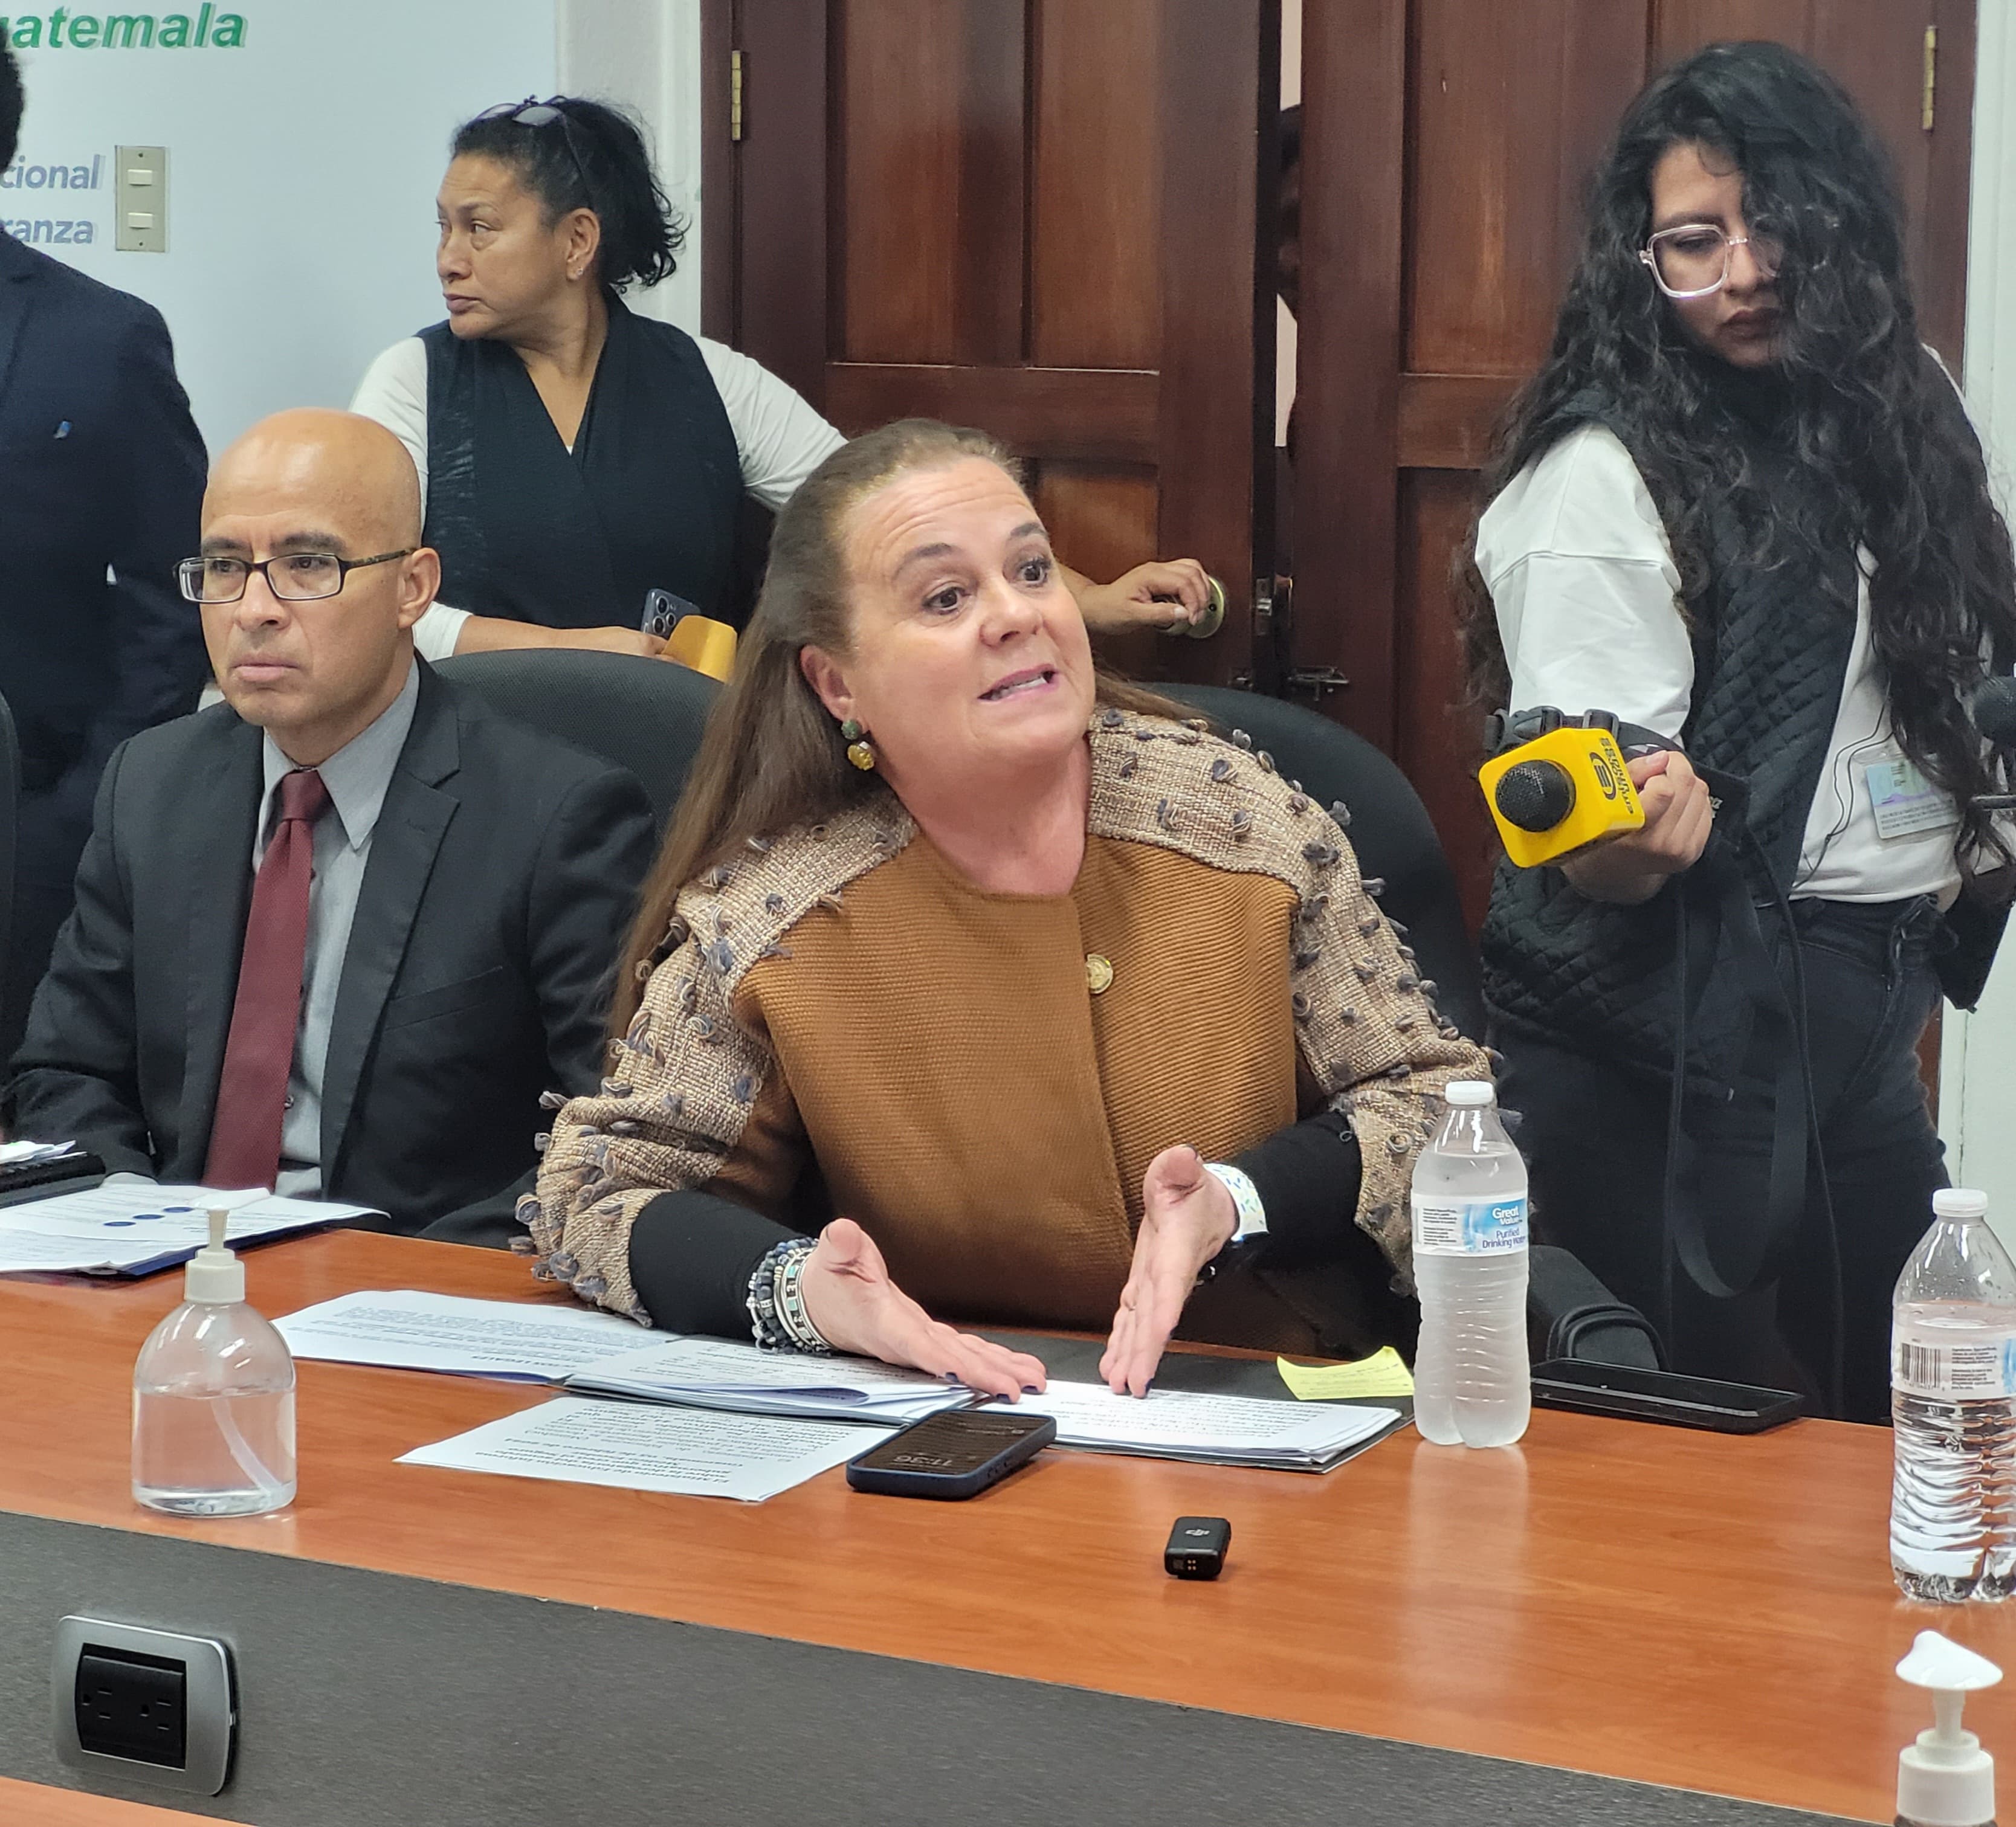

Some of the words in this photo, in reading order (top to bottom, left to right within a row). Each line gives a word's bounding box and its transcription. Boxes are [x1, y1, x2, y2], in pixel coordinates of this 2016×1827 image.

[0, 2, 245, 48] atemala
[1492, 1205, 1519, 1219] Great
[1496, 1228, 1519, 1239] Purified
[1482, 1240, 1512, 1248] Drinking
[893, 1455, 952, 1466] 11:36
